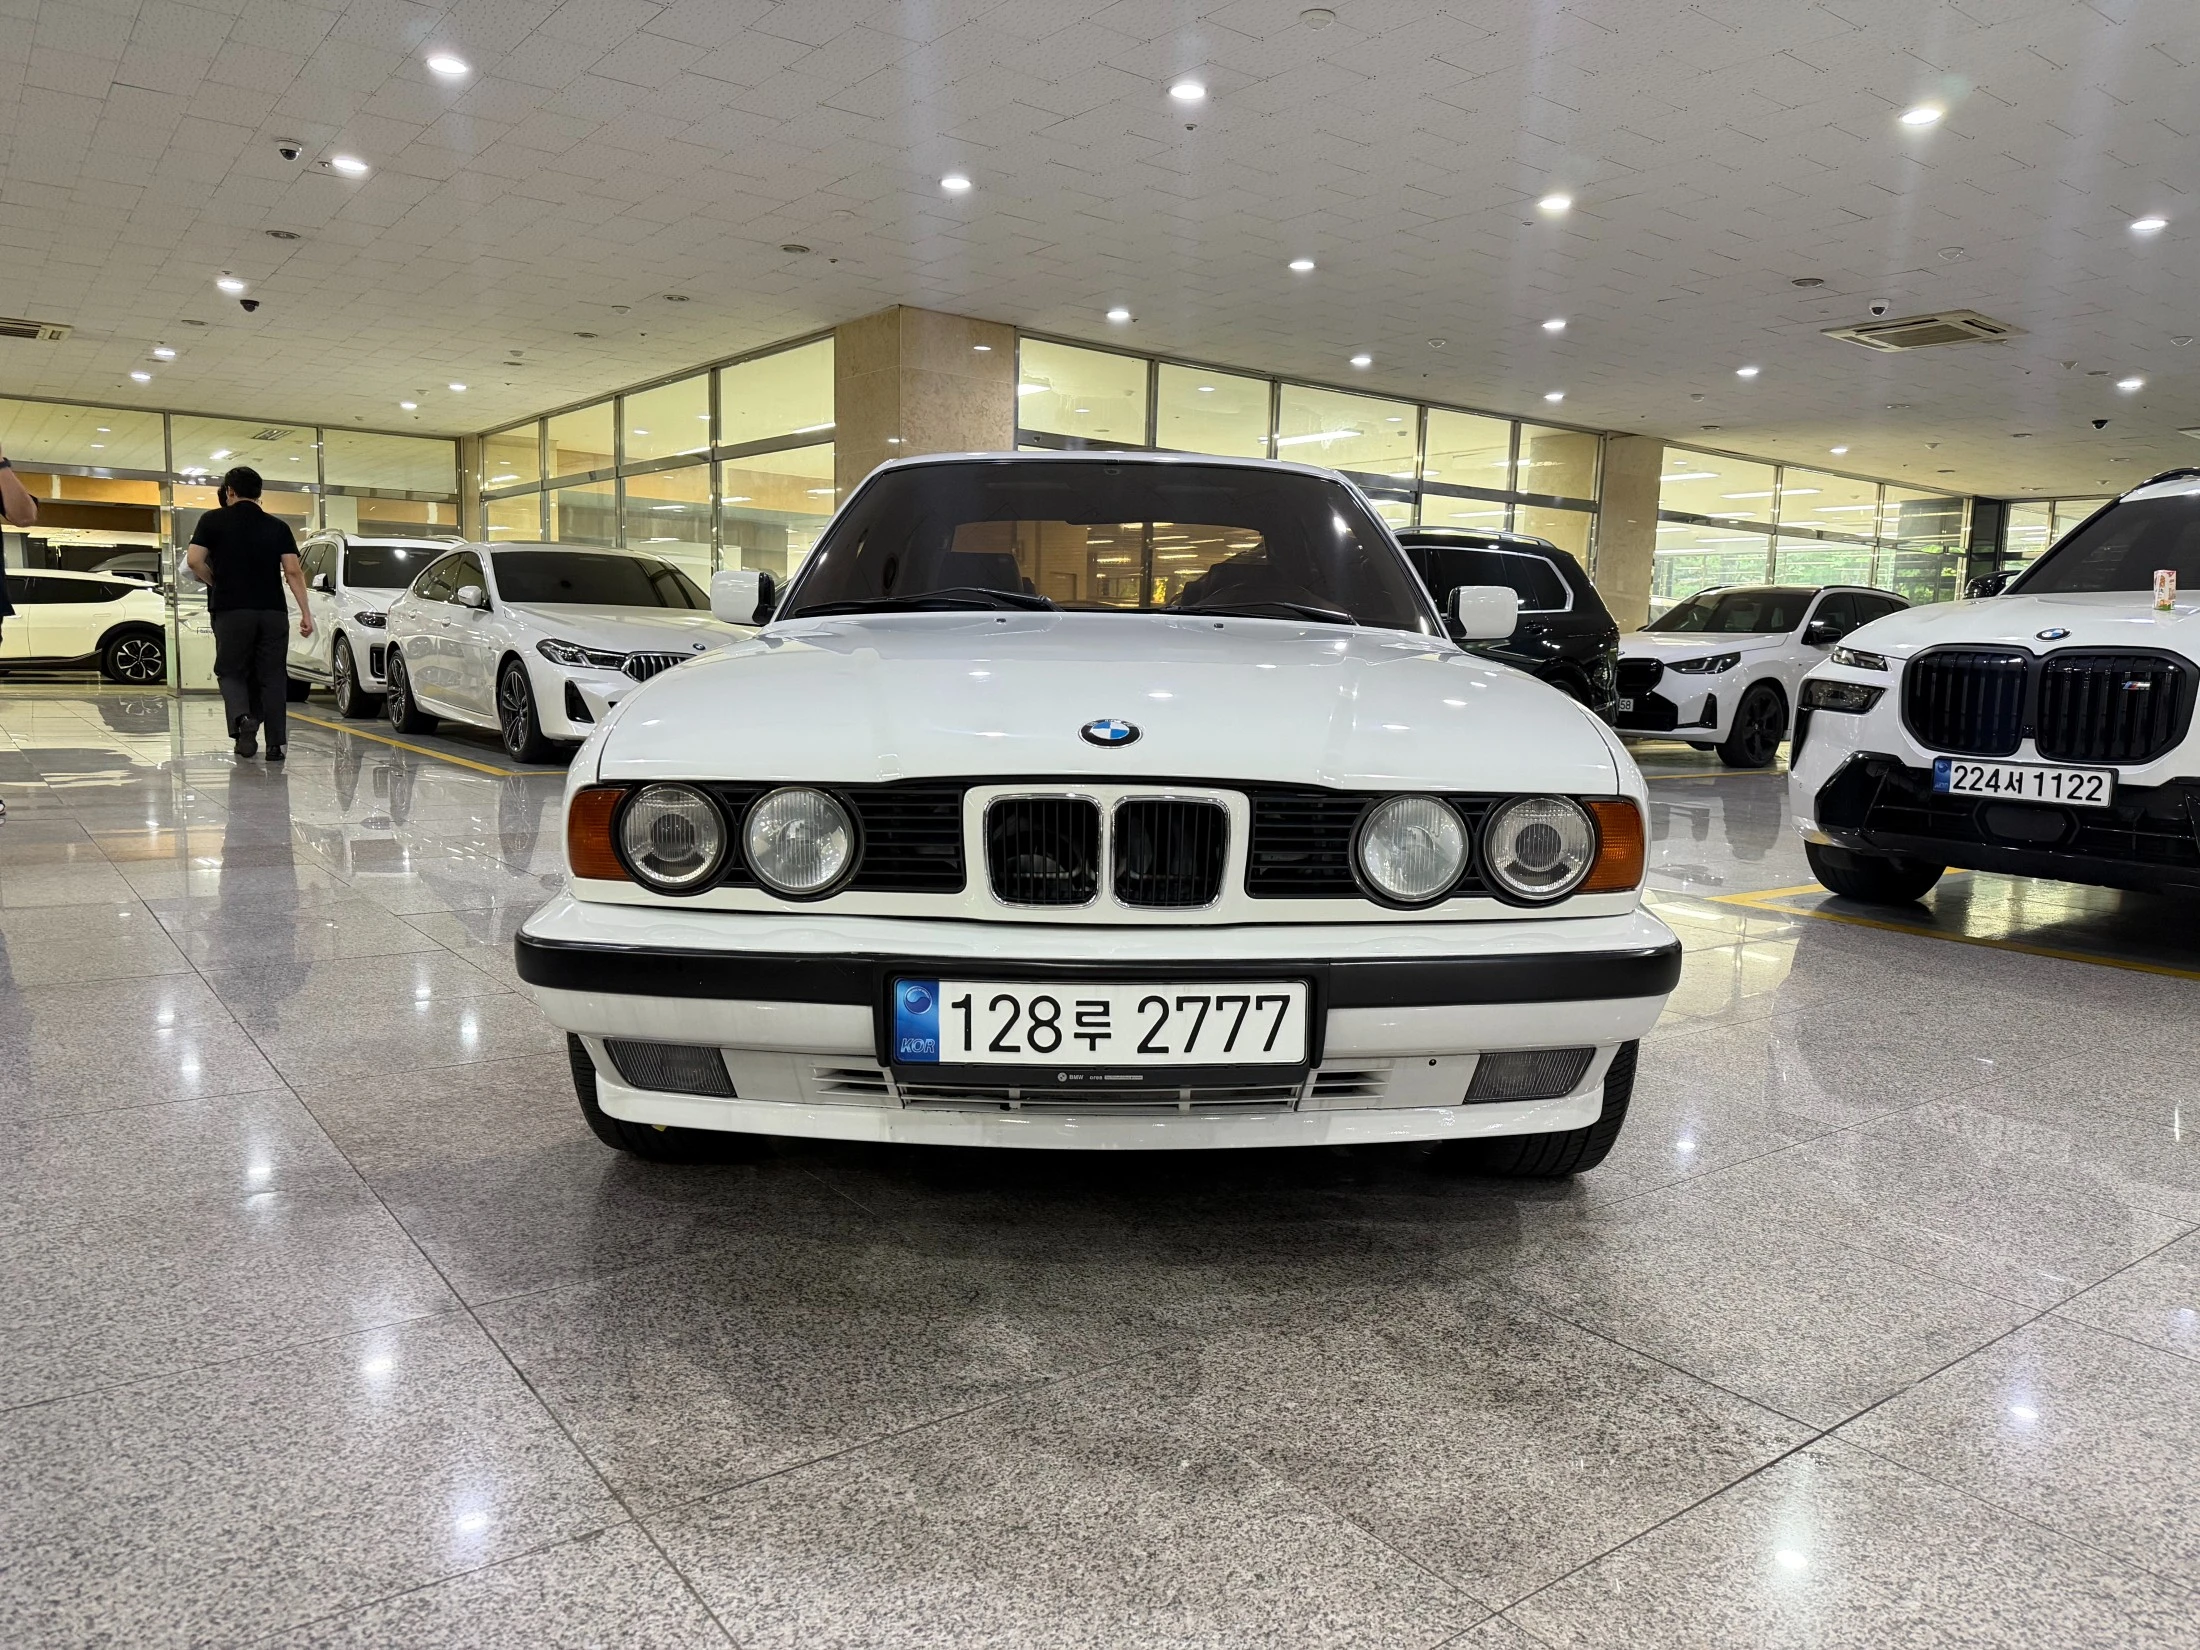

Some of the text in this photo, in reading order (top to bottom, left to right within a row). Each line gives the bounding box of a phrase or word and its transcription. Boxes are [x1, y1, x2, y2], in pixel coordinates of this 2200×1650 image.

[1952, 764, 2104, 802] 224서 1122
[951, 994, 1291, 1054] 128루 2777
[900, 1037, 936, 1053] KOR
